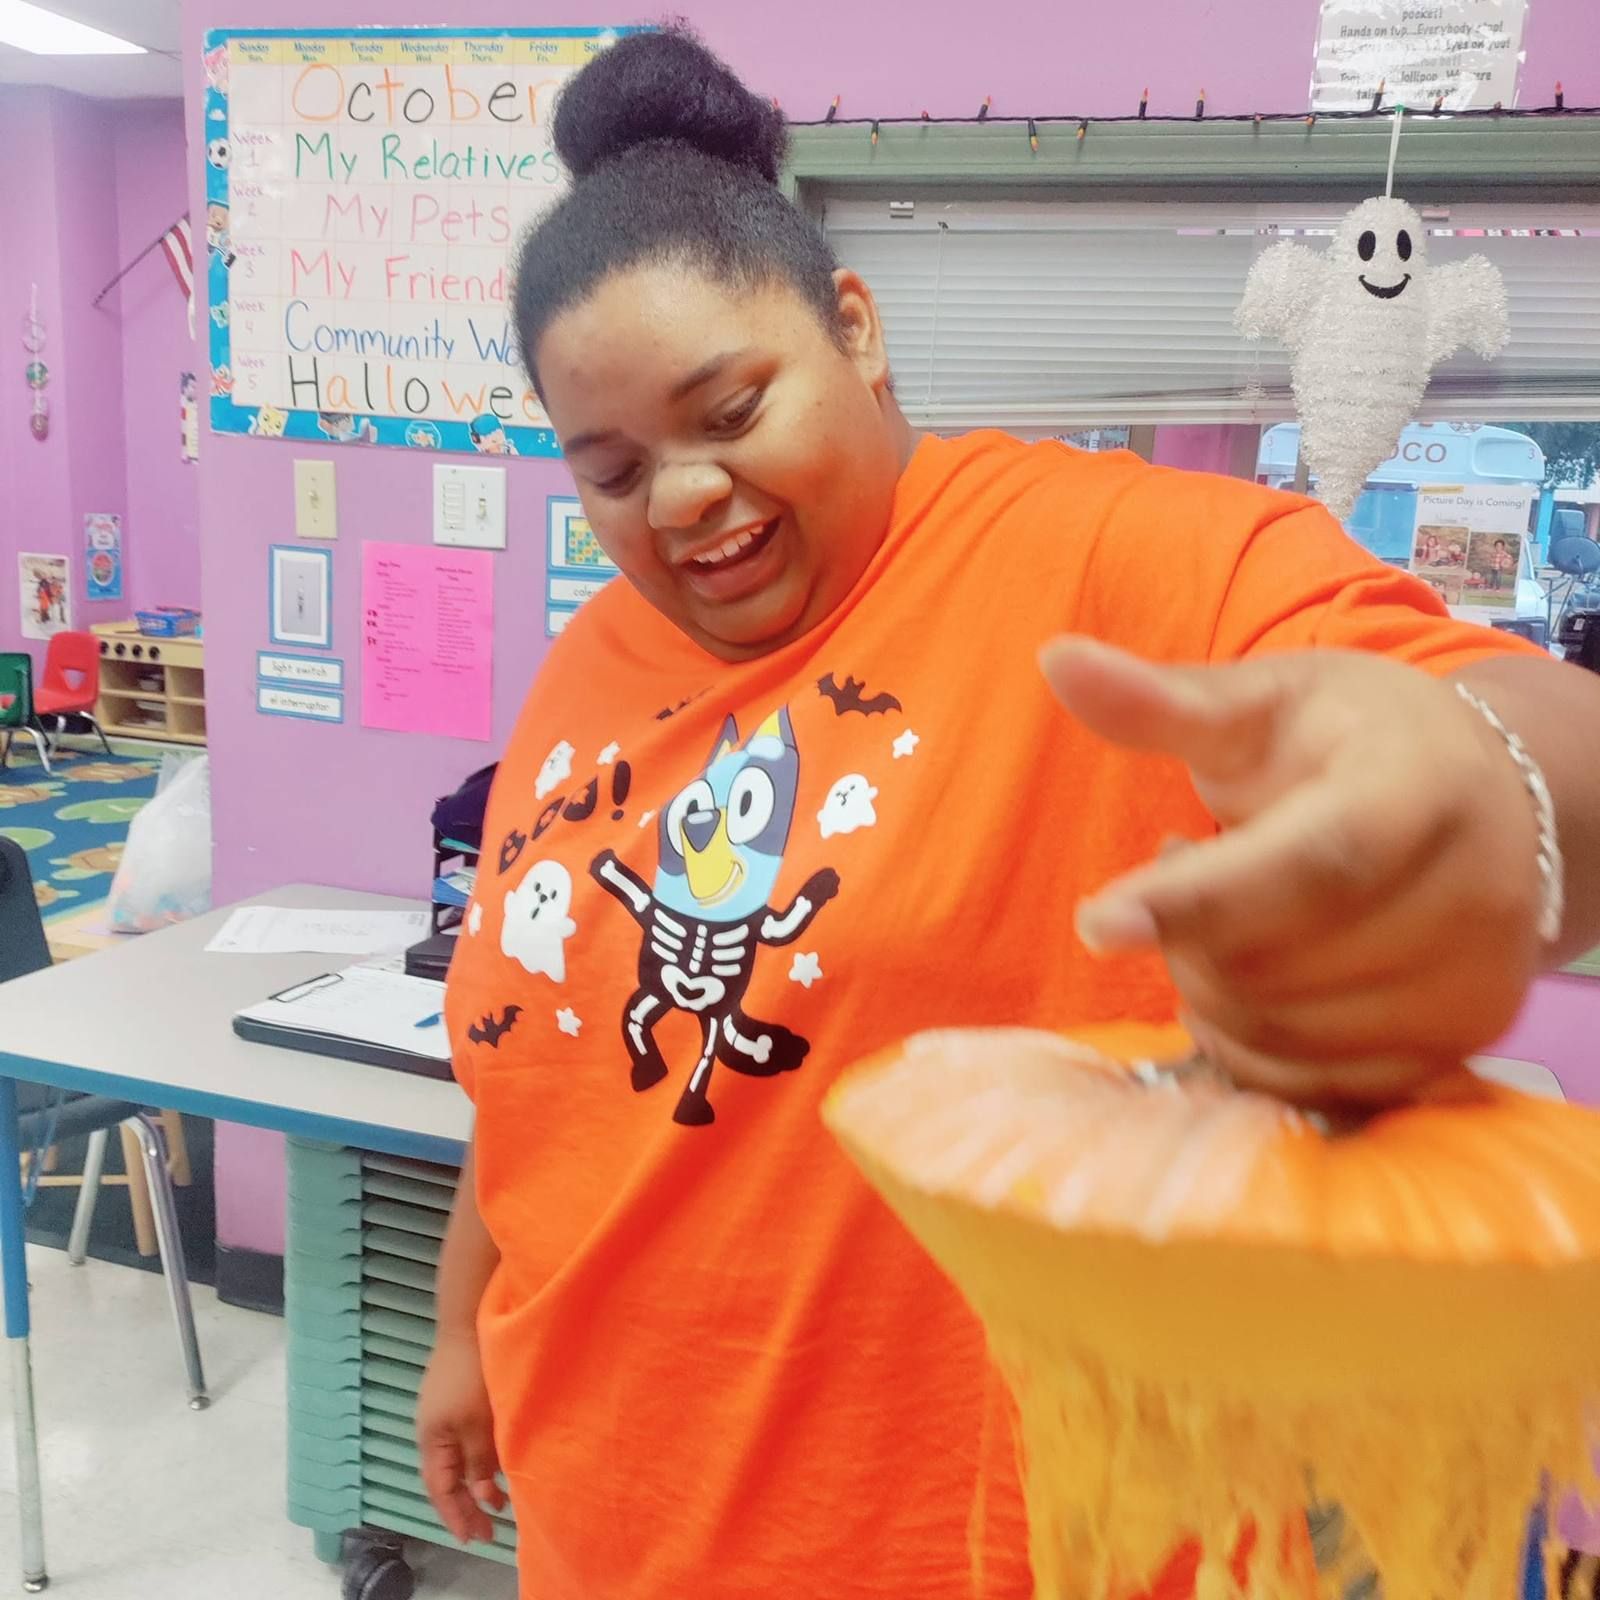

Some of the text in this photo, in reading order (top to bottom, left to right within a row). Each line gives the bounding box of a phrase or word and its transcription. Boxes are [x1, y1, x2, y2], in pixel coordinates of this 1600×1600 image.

[1340, 25, 1371, 38] Hands
[1374, 27, 1388, 37] on
[1475, 21, 1504, 34] sp!
[239, 42, 270, 53] Sunday
[294, 42, 326, 53] Monday
[350, 42, 384, 54] Tuesday
[401, 42, 450, 54] Wednesday
[464, 42, 505, 54] Thursday
[529, 42, 559, 54] Friday
[1471, 40, 1485, 49] on
[292, 63, 561, 126] October
[232, 130, 273, 145] Week
[295, 132, 561, 184] My Relatives
[324, 194, 512, 244] My Pets
[290, 249, 510, 302] My Friend
[235, 299, 266, 313] Week
[285, 300, 520, 368] Community Wo
[238, 356, 265, 369] Week
[287, 356, 543, 421] Hallowee
[1391, 442, 1447, 463] CO
[1424, 494, 1526, 510] Picture Day is Coming!
[272, 660, 329, 679] light switch
